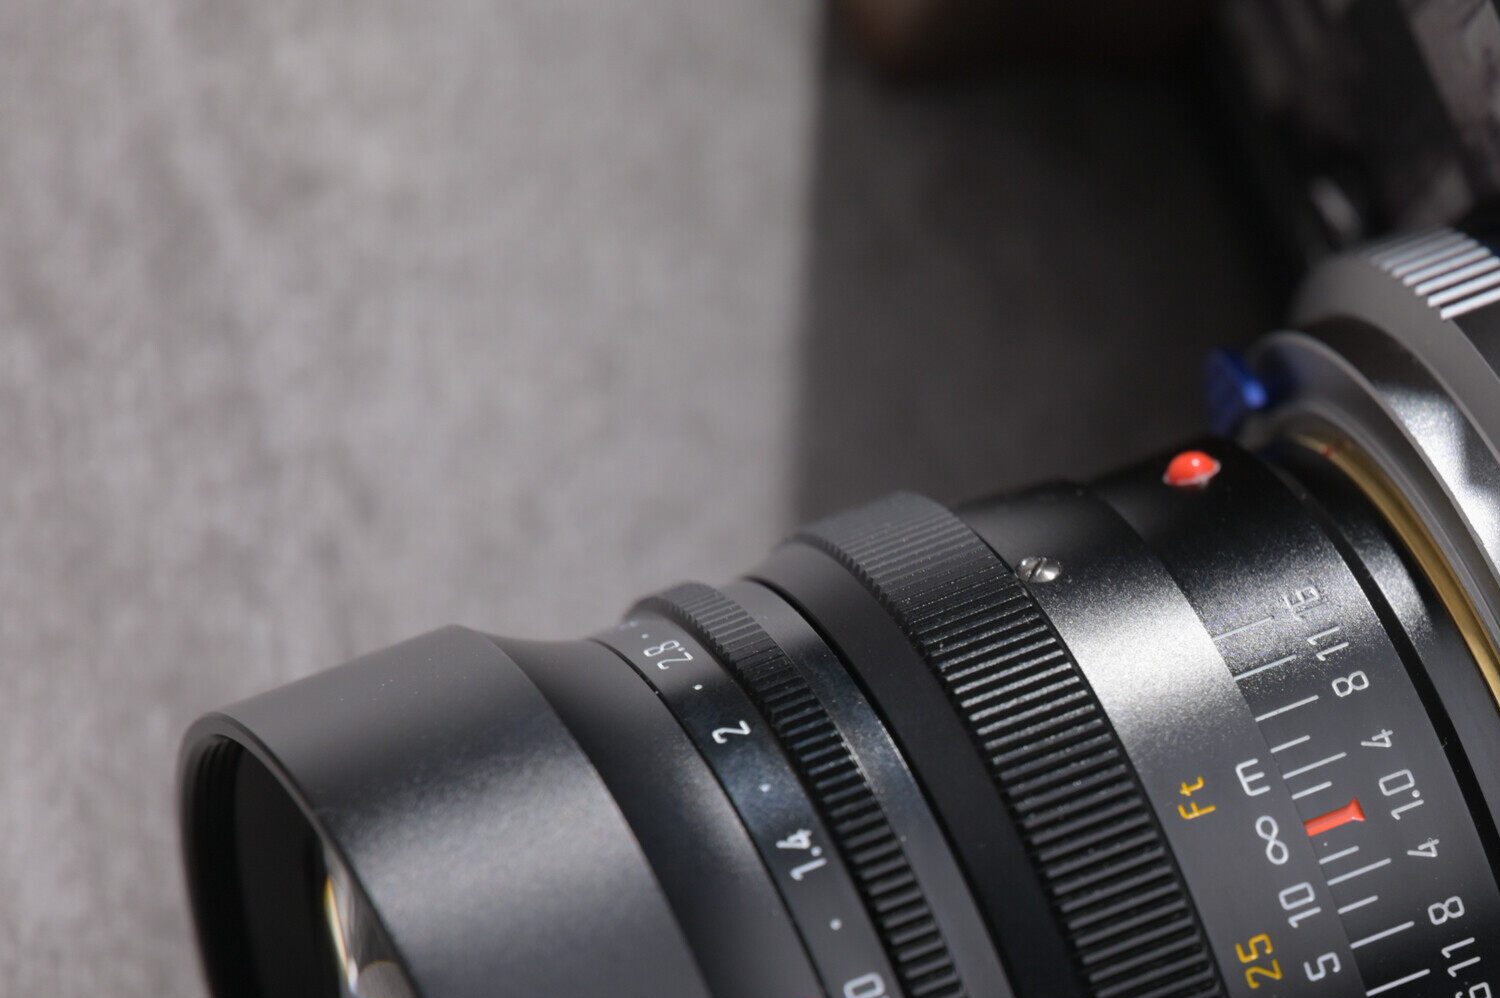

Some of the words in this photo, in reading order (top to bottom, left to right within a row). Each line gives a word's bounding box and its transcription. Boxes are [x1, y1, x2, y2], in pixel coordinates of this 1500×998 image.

[1306, 625, 1350, 661] 11
[1331, 670, 1369, 697] 8
[1361, 729, 1393, 748] 4
[643, 640, 694, 670] 2.8
[711, 720, 751, 744] 2
[776, 829, 828, 881] 1.4
[1235, 758, 1271, 796] m
[1378, 769, 1424, 820] 1.0
[1408, 837, 1440, 858] 4
[1278, 881, 1321, 928] 10
[1428, 896, 1465, 925] 8
[1236, 933, 1283, 990] 25
[1304, 952, 1341, 982] 5
[1441, 937, 1481, 978] 11
